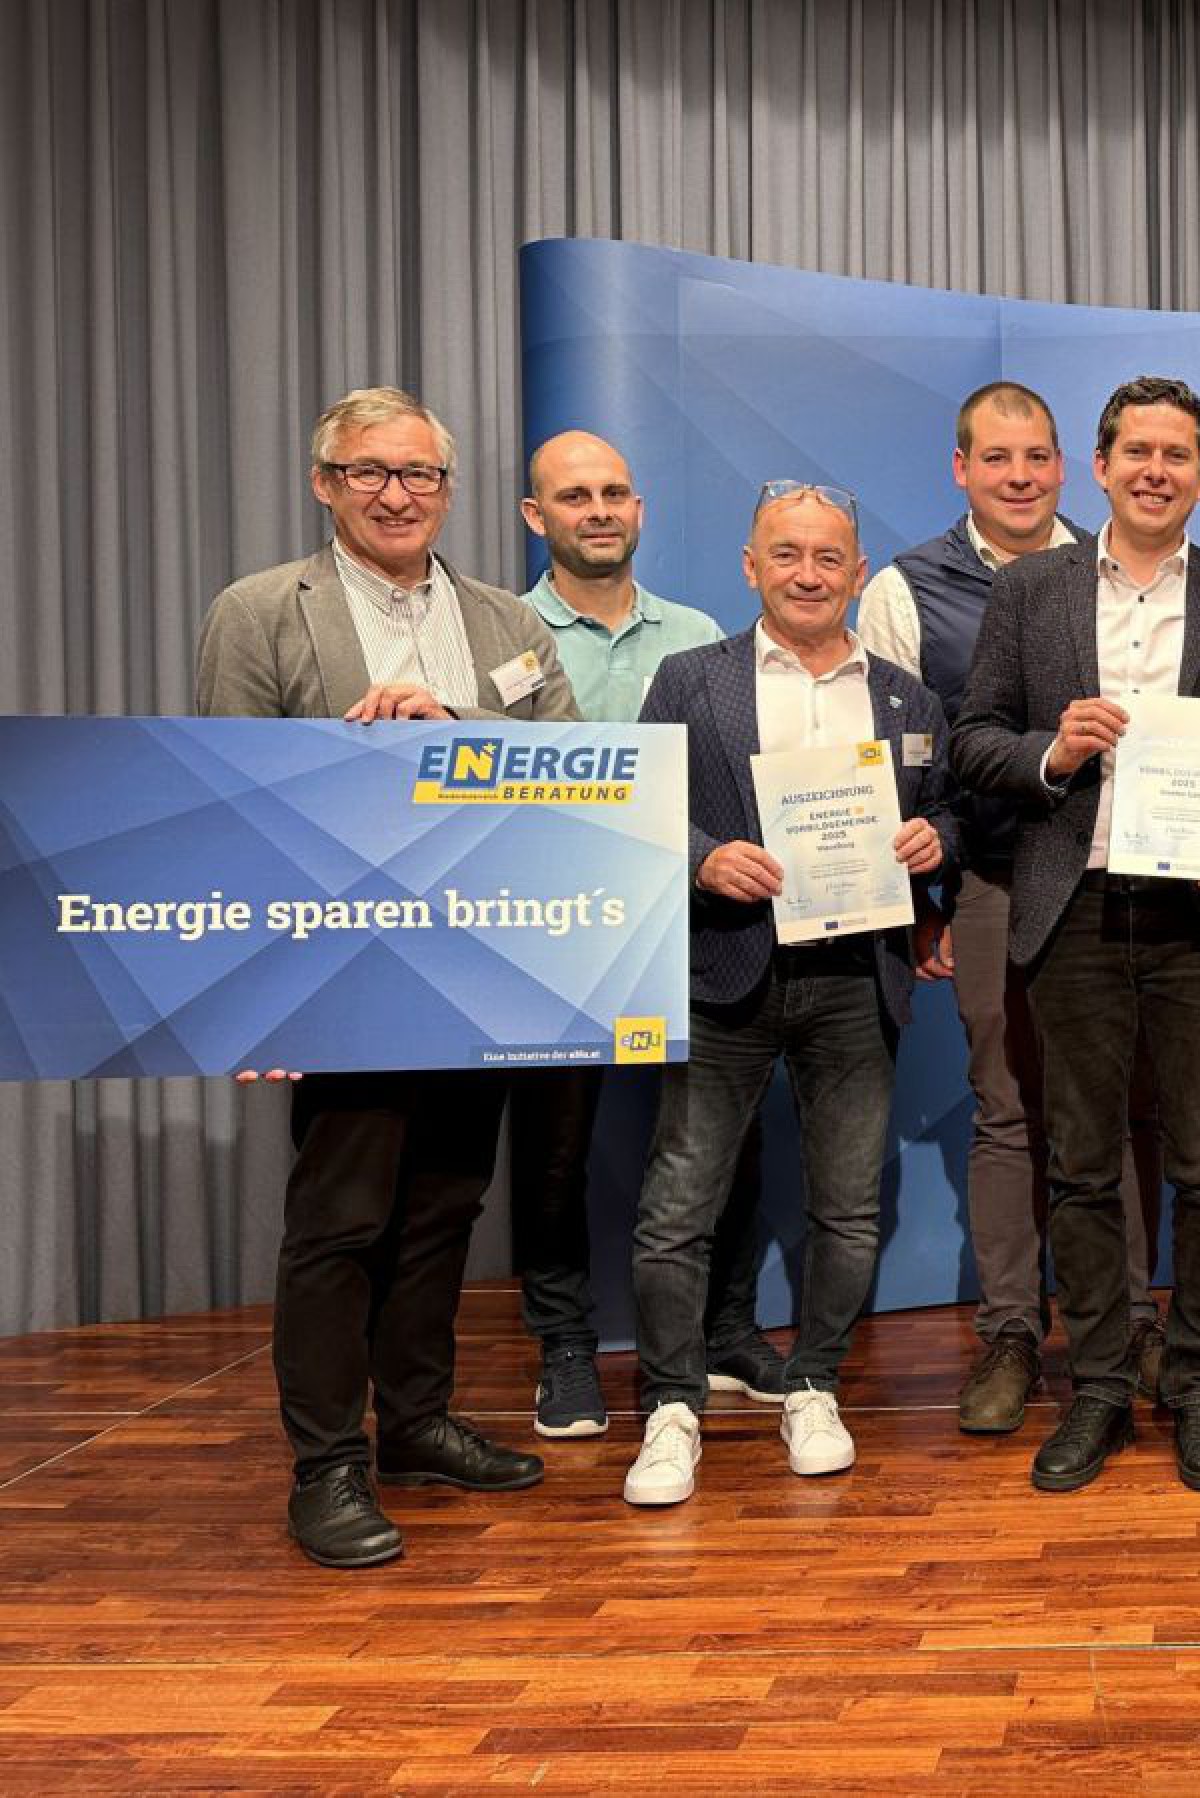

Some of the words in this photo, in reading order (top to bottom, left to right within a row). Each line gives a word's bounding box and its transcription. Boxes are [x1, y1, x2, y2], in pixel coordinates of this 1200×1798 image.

[417, 738, 639, 787] ENERGIE
[503, 785, 627, 800] BERATUNG
[781, 784, 875, 806] AUSZEICHNUNG
[809, 807, 851, 820] ENERGIE
[786, 815, 879, 834] VORBILDGEMEINDE
[57, 891, 251, 941] Energie
[266, 901, 432, 939] sparen
